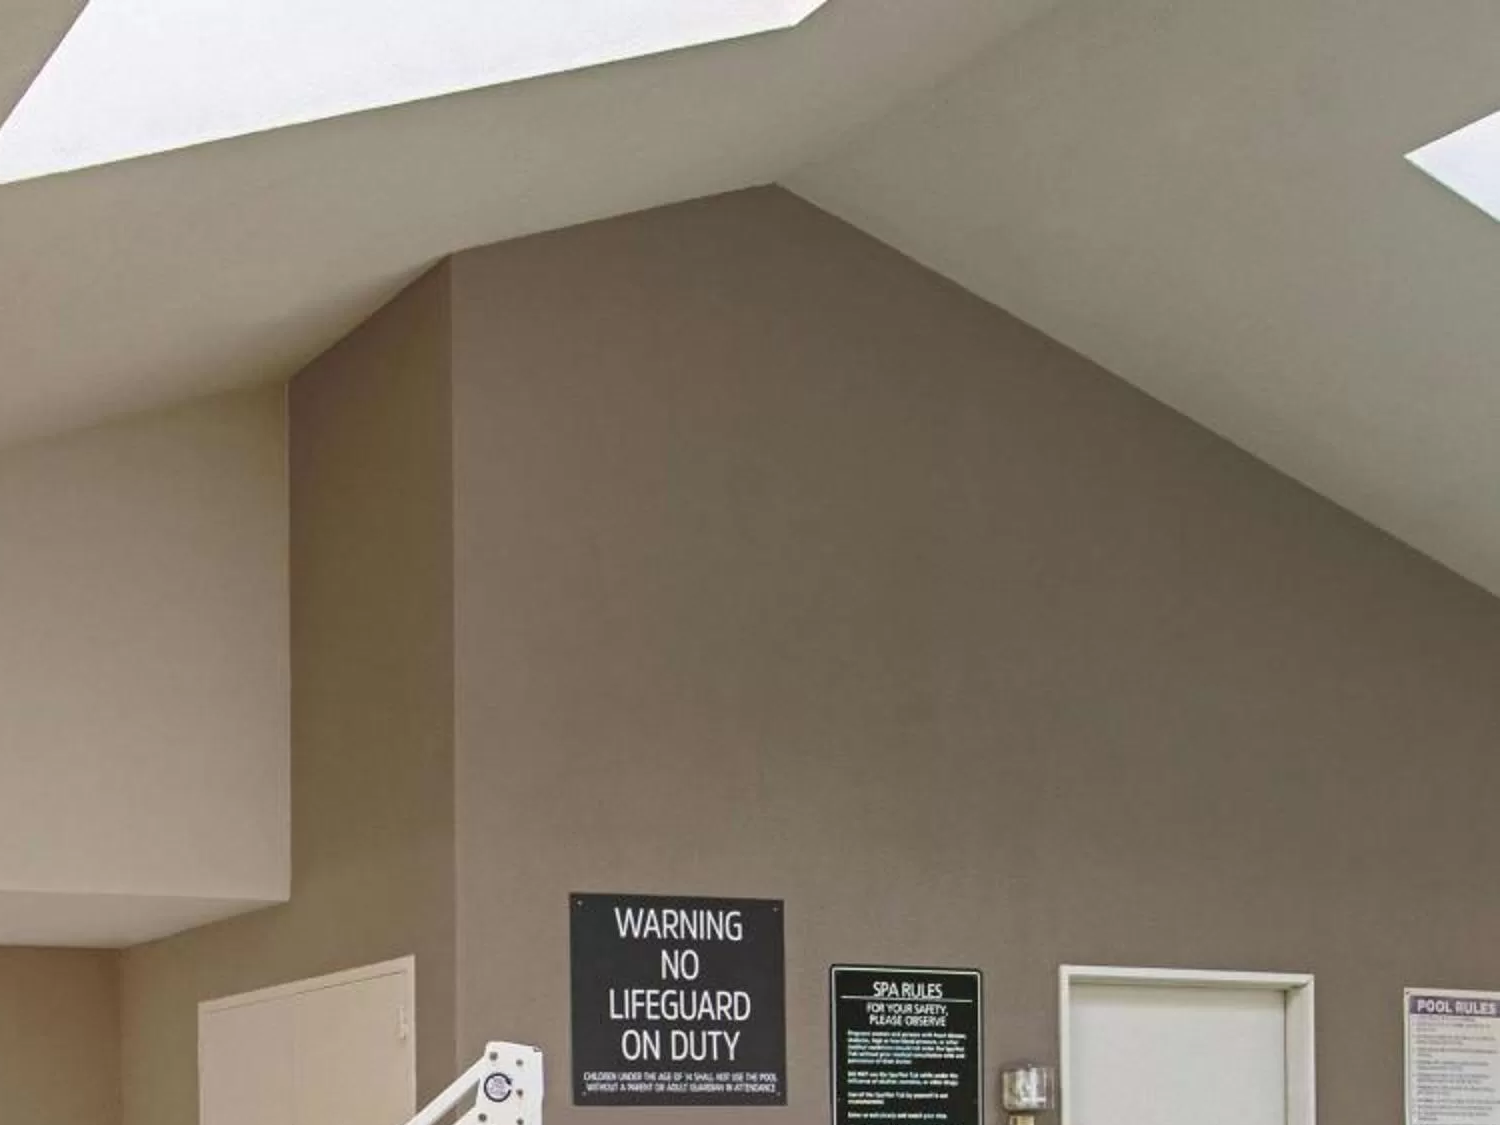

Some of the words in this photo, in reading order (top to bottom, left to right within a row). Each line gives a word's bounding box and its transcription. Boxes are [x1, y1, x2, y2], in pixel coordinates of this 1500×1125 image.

[614, 907, 744, 941] WARNING
[661, 949, 700, 980] NO
[873, 981, 899, 997] SPA
[901, 982, 943, 999] RULES
[609, 988, 751, 1021] LIFEGUARD
[866, 1002, 885, 1013] FOR
[886, 1003, 913, 1014] YOUR
[1417, 999, 1453, 1013] POOL
[1455, 1001, 1497, 1015] RULES
[869, 1014, 902, 1025] PLEASE
[621, 1029, 661, 1061] ON
[671, 1030, 741, 1061] DUTY
